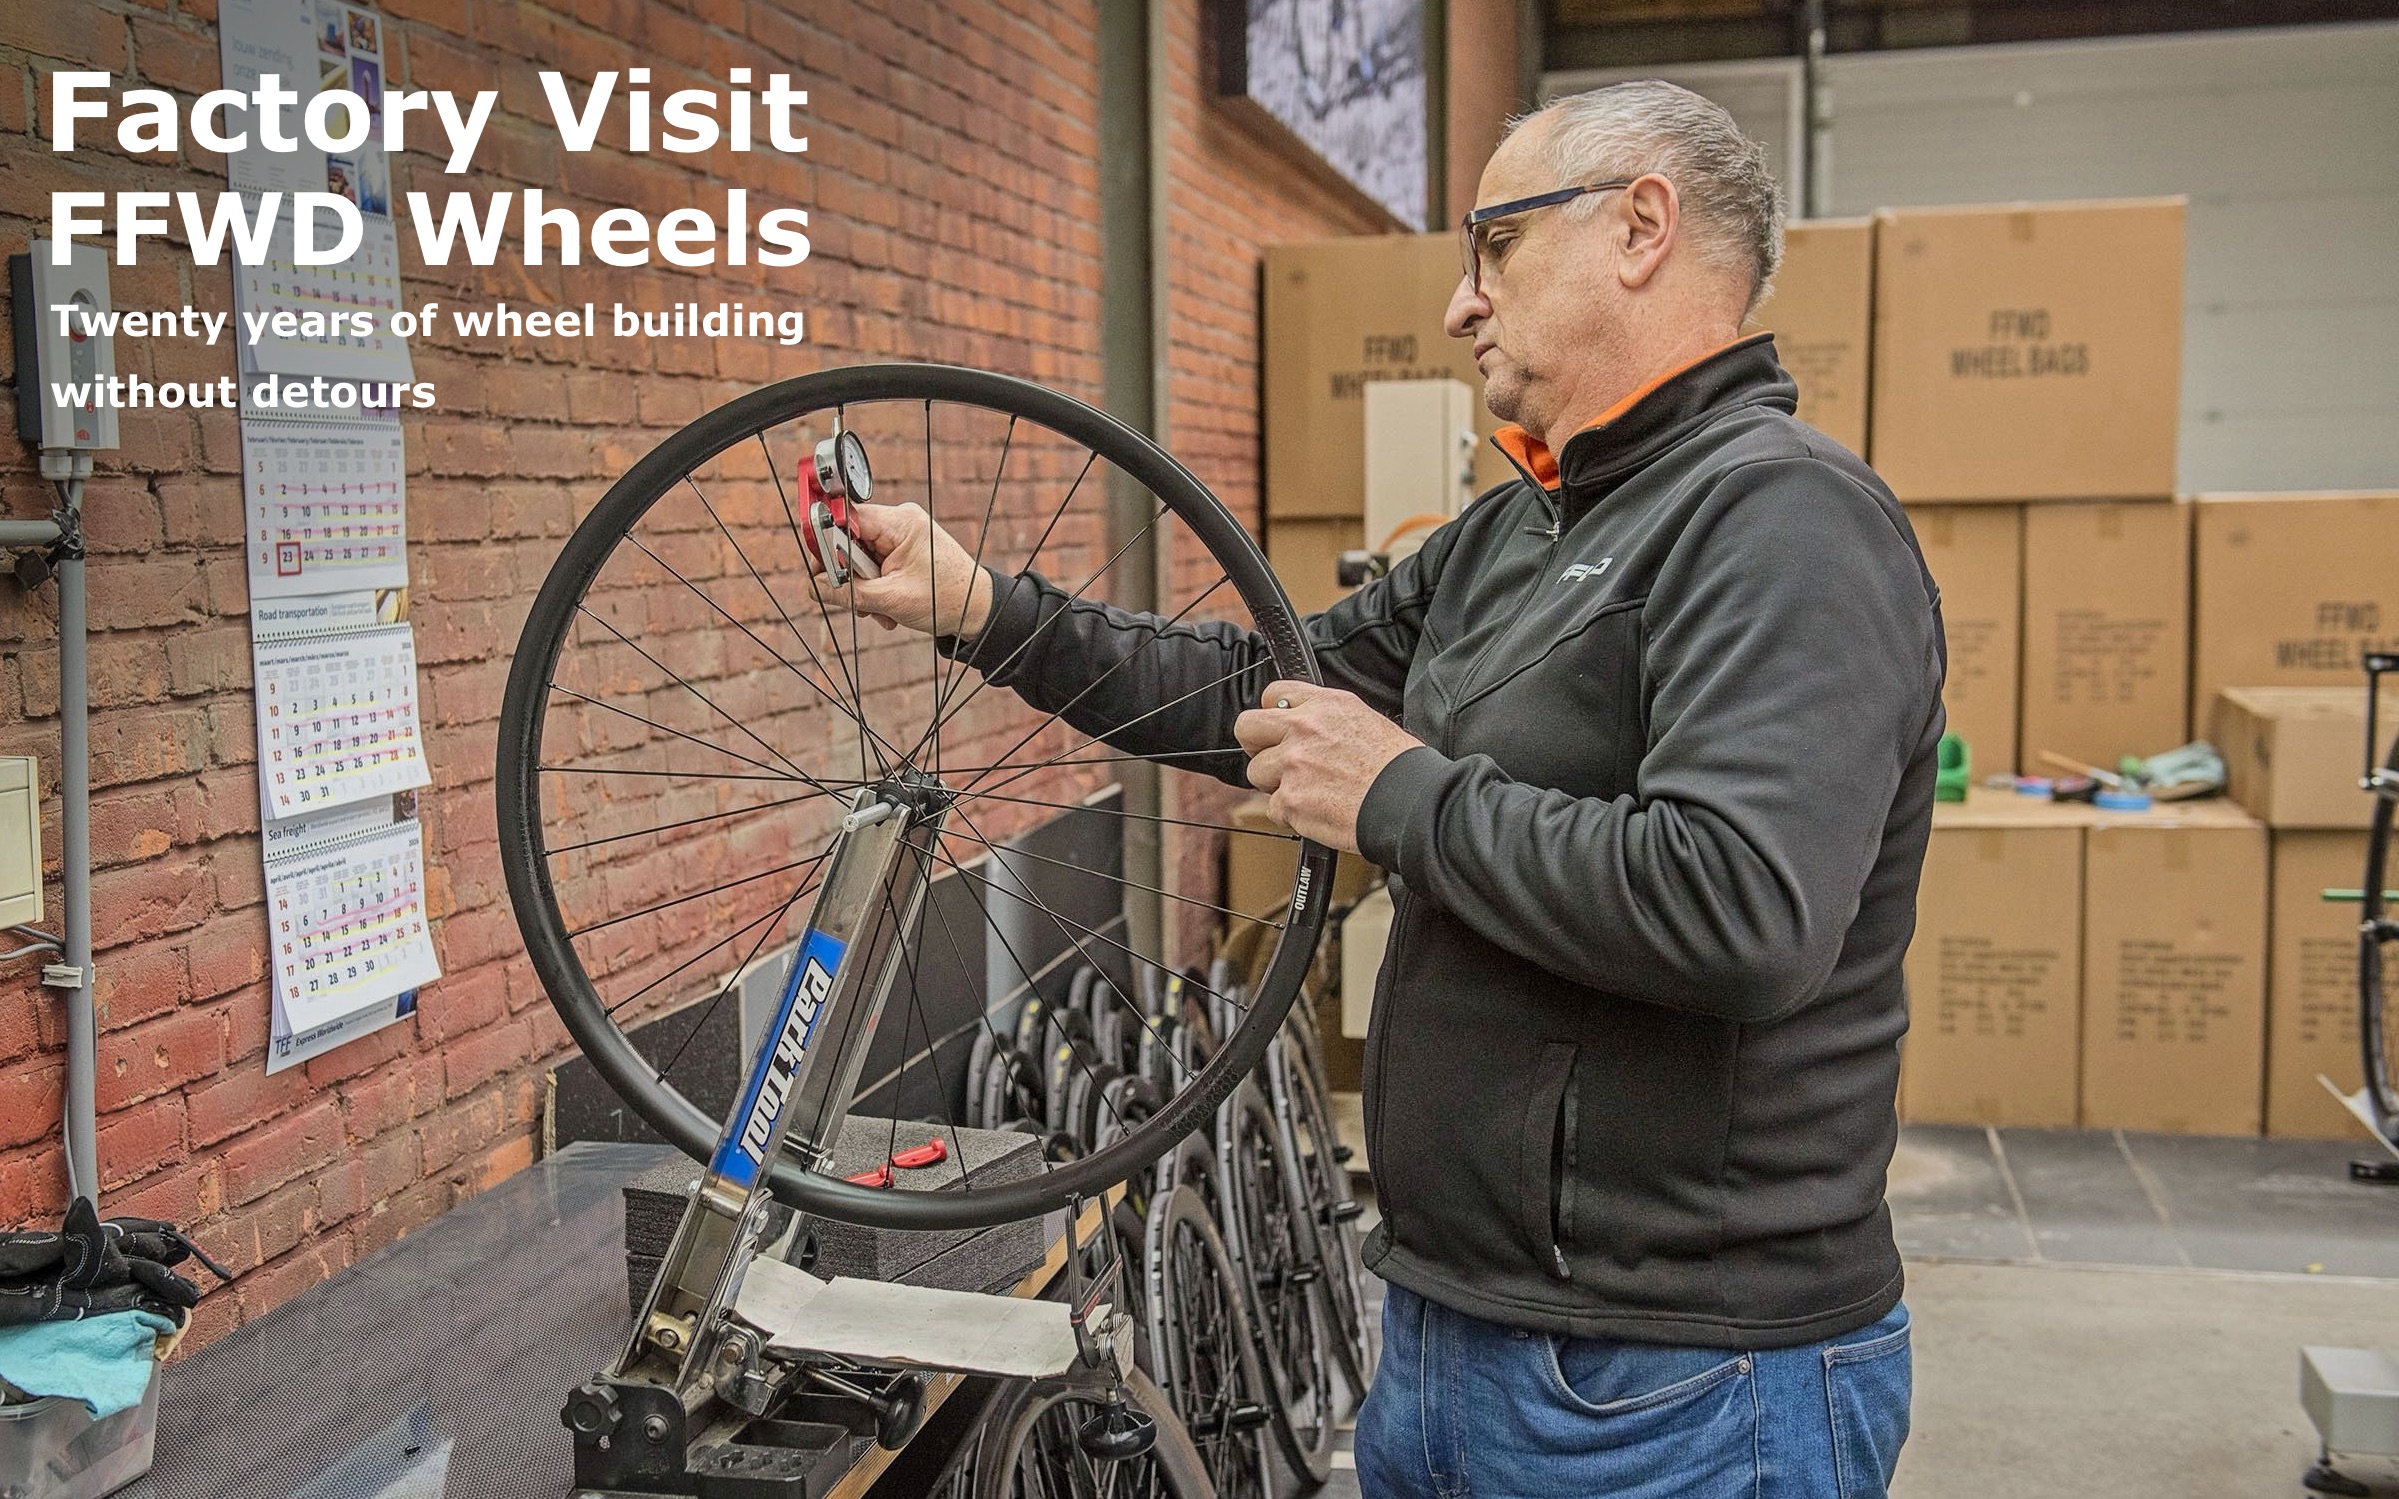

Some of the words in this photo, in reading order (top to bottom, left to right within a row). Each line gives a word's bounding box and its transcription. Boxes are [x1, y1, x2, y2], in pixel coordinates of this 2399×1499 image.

[1990, 308, 2050, 339] FFWD
[1363, 335, 1417, 363] FFWD
[1952, 346, 2022, 379] WHEEL
[2028, 342, 2089, 376] BAGS
[258, 485, 265, 495] 6
[281, 485, 287, 494] 2
[302, 484, 308, 494] 3
[321, 484, 328, 494] 4
[341, 484, 347, 494] 5
[260, 508, 266, 518] 7
[282, 507, 288, 517] 9
[303, 506, 310, 517] 10
[324, 506, 330, 516] 11
[342, 505, 349, 515] 12
[359, 504, 366, 515] 13
[376, 504, 382, 514] 14
[260, 531, 267, 541] 8
[283, 529, 291, 539] 16
[304, 528, 312, 538] 17
[324, 527, 331, 538] 18
[343, 527, 350, 537] 19
[360, 526, 368, 536] 20
[377, 526, 384, 535] 21
[261, 553, 268, 563] 9
[283, 551, 292, 562] 23
[305, 550, 313, 561] 24
[325, 549, 333, 560] 25
[361, 547, 369, 558] 27
[259, 608, 277, 621] Road
[279, 605, 328, 620] transportation
[2316, 602, 2378, 633] FFWD
[2278, 639, 2352, 670] WHEEL
[269, 683, 276, 694] 9
[270, 705, 278, 717] 10
[292, 703, 299, 713] 2
[312, 700, 319, 710] 3
[331, 697, 338, 707] 4
[351, 694, 357, 704] 5
[369, 691, 375, 702] 6
[386, 689, 392, 698] 7
[272, 728, 279, 739] 11
[293, 725, 300, 736] 9
[313, 721, 321, 732] 10
[333, 719, 340, 729] 11
[351, 715, 358, 725] 12
[369, 713, 376, 723] 13
[387, 710, 394, 719] 14
[403, 706, 410, 717] 15
[274, 750, 282, 762] 12
[294, 747, 302, 758] 16
[315, 743, 322, 754] 17
[334, 740, 341, 751] 18
[352, 737, 360, 747] 19
[370, 733, 378, 743] 20
[388, 730, 395, 740] 21
[405, 727, 412, 737] 22
[276, 772, 285, 784] 13
[296, 768, 306, 780] 23
[316, 765, 325, 776] 24
[335, 762, 344, 772] 25
[354, 758, 363, 768] 26
[372, 754, 381, 764] 27
[390, 750, 399, 761] 28
[408, 747, 416, 757] 29
[280, 795, 290, 806] 14
[300, 790, 310, 802] 30
[321, 786, 329, 797] 31
[268, 826, 282, 841] Sea
[283, 823, 307, 838] freight
[279, 900, 288, 911] 14
[340, 883, 345, 892] 1
[358, 878, 363, 888] 2
[375, 872, 381, 882] 3
[392, 867, 398, 877] 4
[409, 862, 414, 872] 5
[1294, 865, 1312, 911] OUTLAW
[282, 921, 289, 933] 15
[302, 915, 309, 926] 6
[322, 910, 328, 920] 7
[341, 904, 347, 914] 8
[359, 898, 365, 909] 9
[376, 892, 383, 904] 10
[394, 888, 400, 898] 11
[410, 882, 416, 892] 12
[283, 943, 292, 955] 16
[304, 937, 311, 948] 13
[323, 931, 330, 943] 14
[342, 925, 348, 936] 15
[360, 919, 367, 930] 16
[377, 914, 384, 924] 17
[394, 908, 401, 918] 18
[411, 902, 417, 913] 19
[286, 965, 294, 977] 17
[305, 958, 315, 970] 20
[325, 952, 333, 963] 21
[343, 946, 352, 957] 22
[362, 940, 370, 951] 23
[379, 934, 388, 945] 24
[397, 928, 404, 940] 25
[413, 923, 421, 933] 26
[290, 987, 299, 999] 18
[310, 979, 319, 992] 27
[328, 973, 339, 985] 28
[348, 967, 357, 978] 29
[365, 960, 374, 972] 30
[275, 1035, 292, 1056] TFF
[295, 1033, 316, 1047] Express
[317, 1021, 344, 1039] Worldwide
